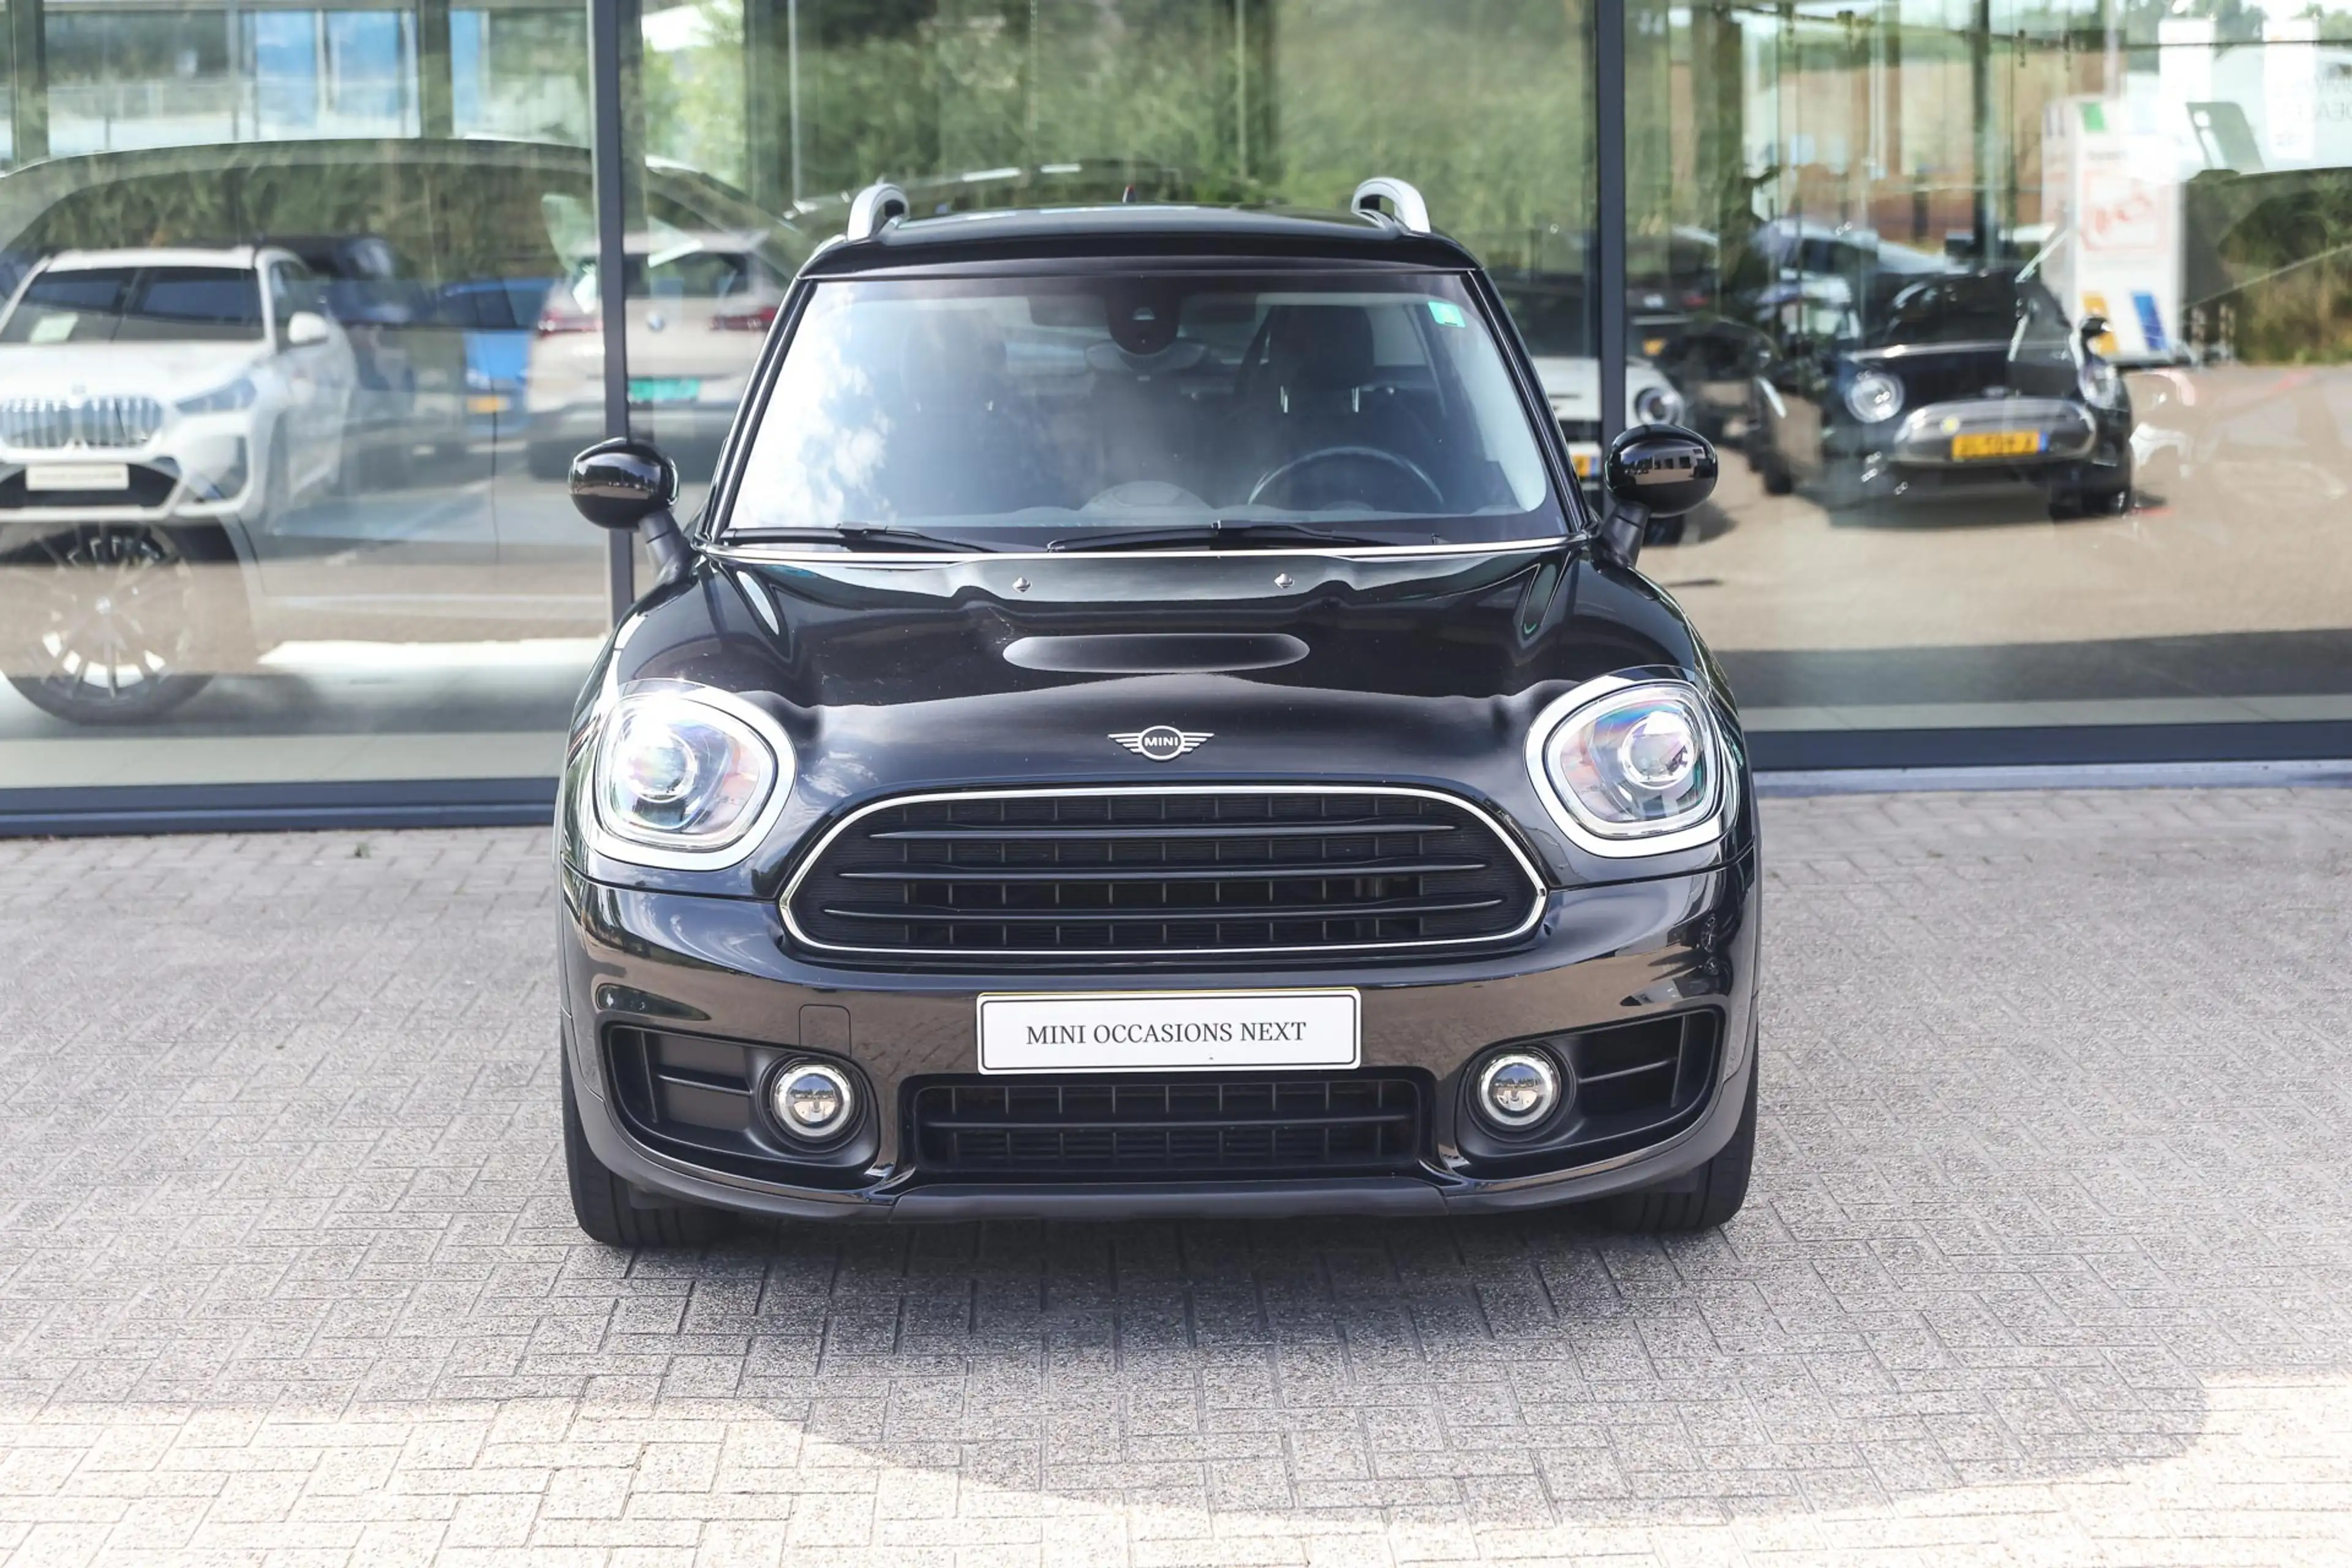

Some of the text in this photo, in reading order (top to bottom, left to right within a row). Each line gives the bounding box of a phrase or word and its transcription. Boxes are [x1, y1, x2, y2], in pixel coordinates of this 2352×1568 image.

[1144, 737, 1178, 747] MINI
[1026, 1021, 1307, 1045] MINI OCCASIONS NEXT
